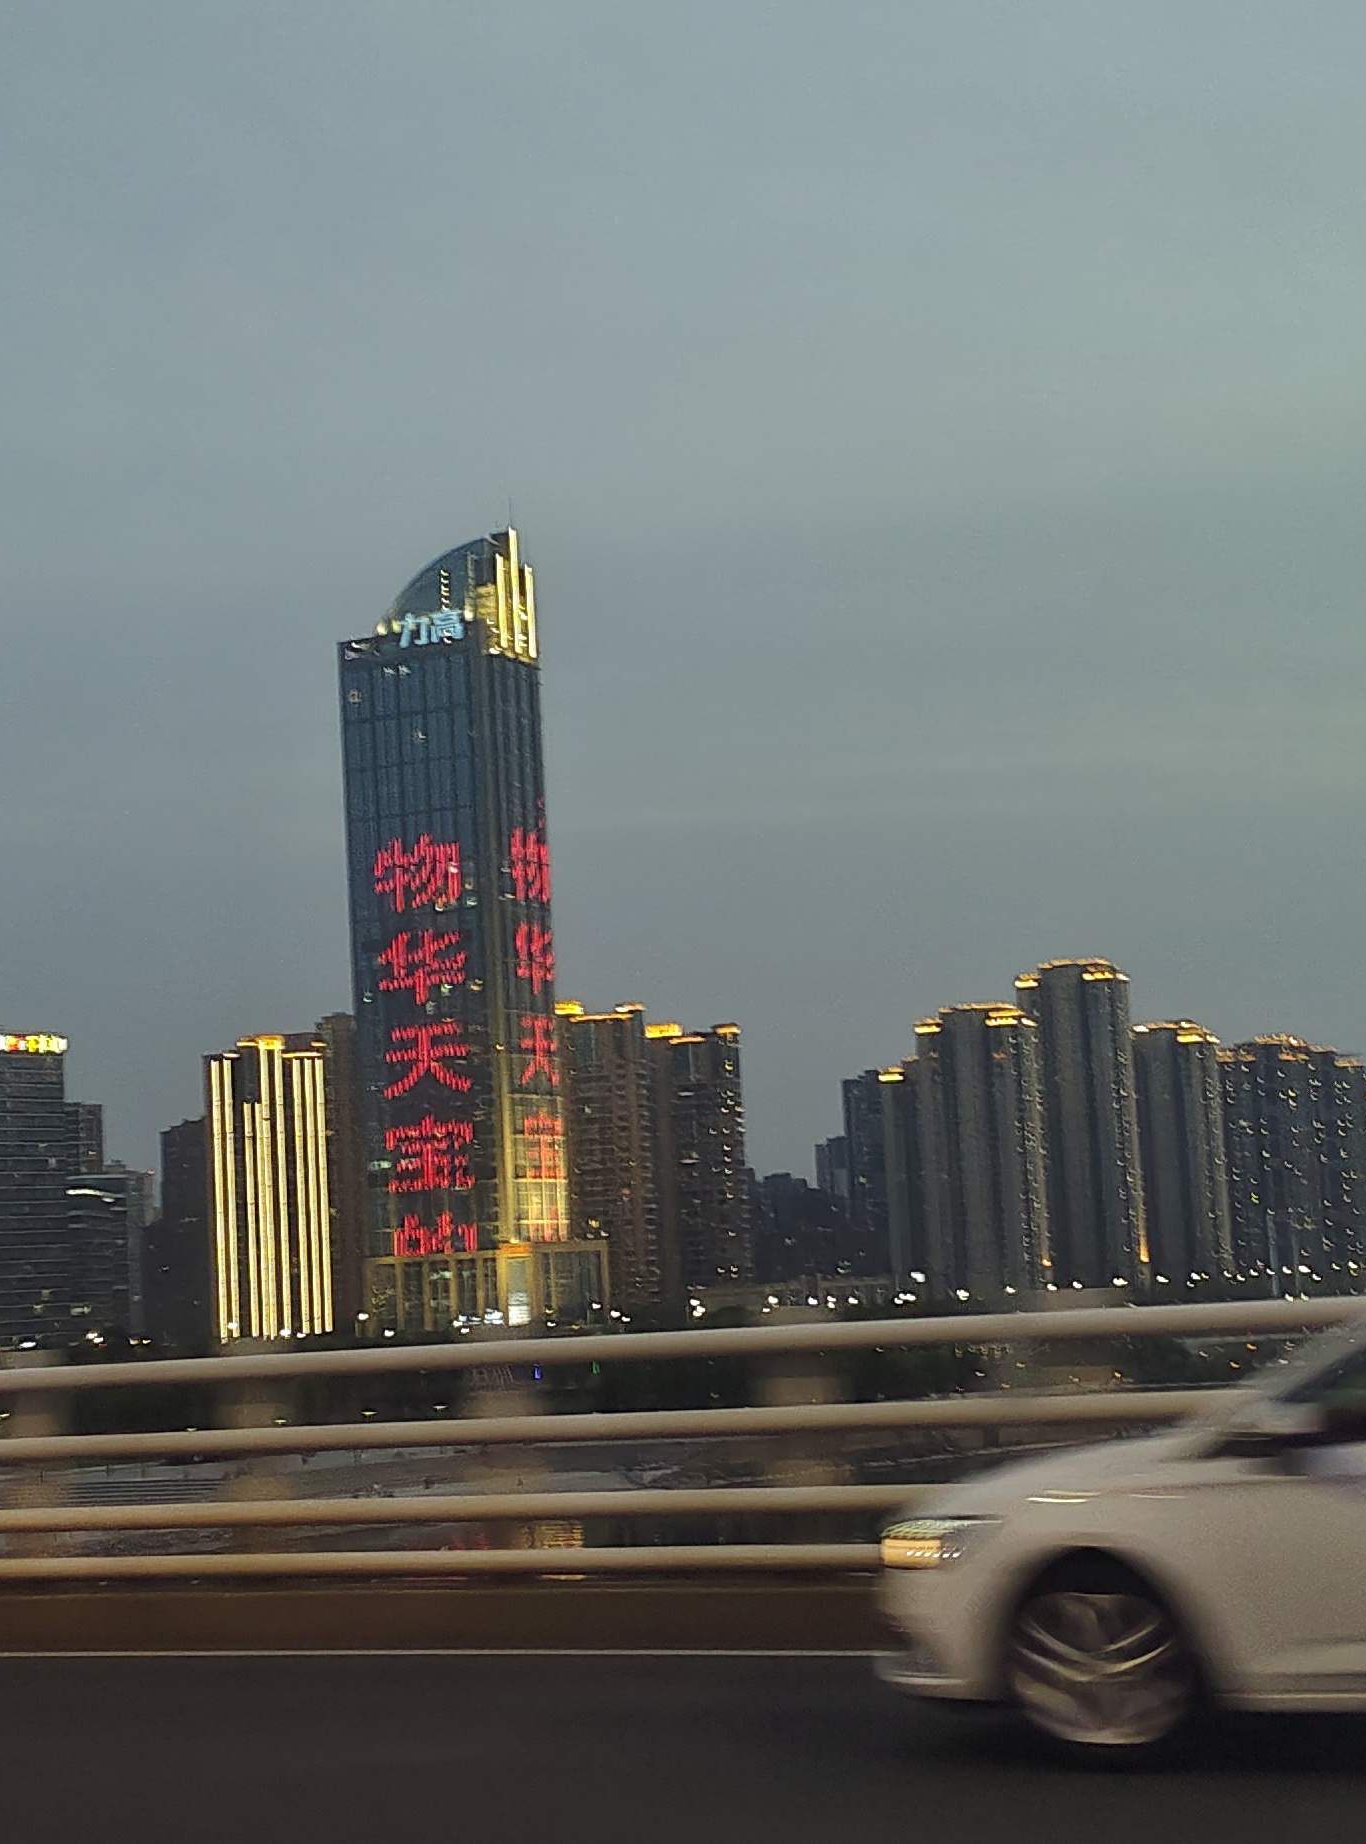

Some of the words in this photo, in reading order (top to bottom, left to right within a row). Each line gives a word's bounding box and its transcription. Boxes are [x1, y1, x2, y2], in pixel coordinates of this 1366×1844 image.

[398, 609, 466, 648] 力高
[510, 826, 566, 1244] 物华天宝
